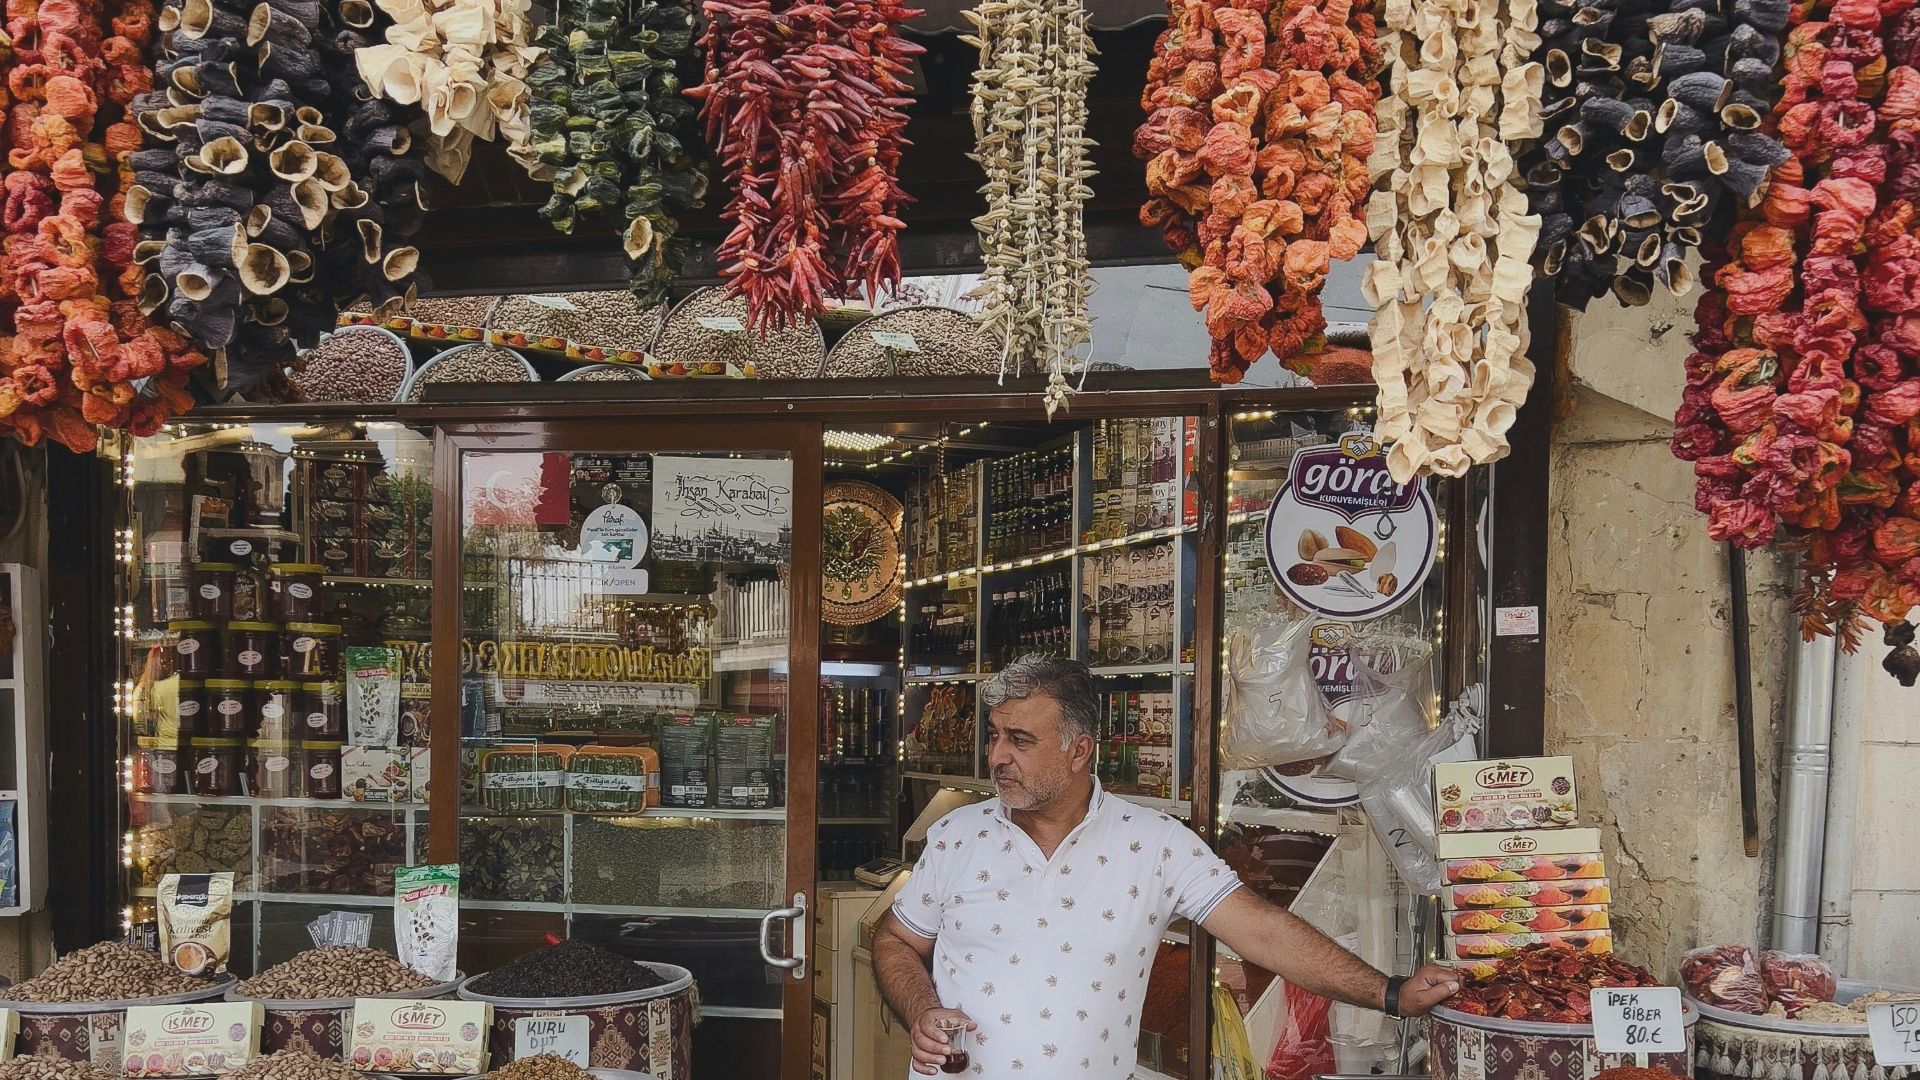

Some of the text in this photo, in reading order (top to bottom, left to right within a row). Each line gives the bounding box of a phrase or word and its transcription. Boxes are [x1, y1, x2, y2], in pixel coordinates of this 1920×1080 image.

[1388, 828, 1413, 848] 2
[1622, 1007, 1661, 1021] BİBER
[527, 1020, 566, 1036] KURU
[530, 1036, 558, 1052] DUT
